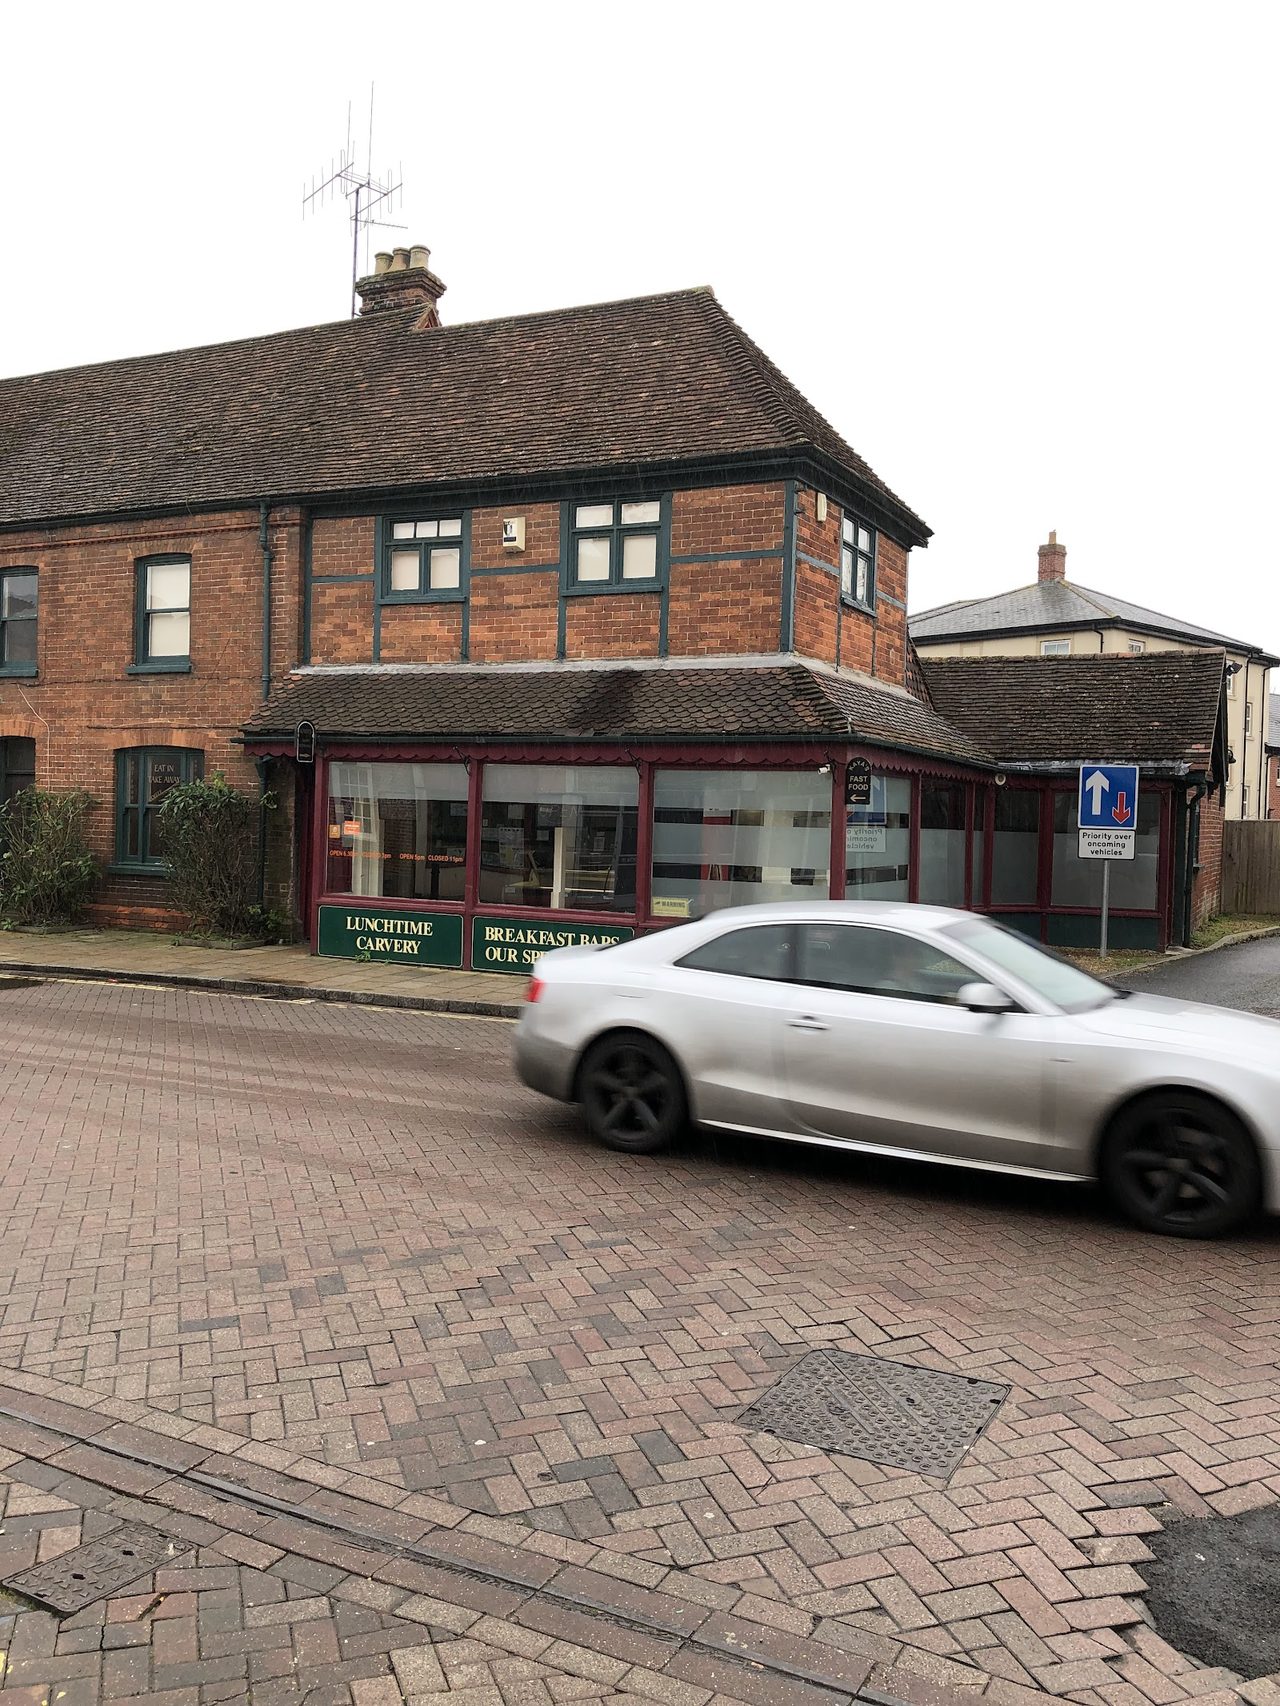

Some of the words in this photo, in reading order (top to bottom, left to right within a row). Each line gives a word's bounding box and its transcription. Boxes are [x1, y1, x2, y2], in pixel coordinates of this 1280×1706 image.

[154, 764, 166, 772] EAT
[167, 764, 174, 772] IN
[848, 760, 870, 772] KAYA'S
[147, 776, 162, 784] TAKE
[163, 776, 180, 784] AWAY
[849, 775, 868, 783] FAST
[848, 783, 869, 791] FOOD
[1082, 832, 1112, 840] Priority
[1087, 841, 1126, 849] oncoming
[346, 916, 434, 936] LUNCHTIME
[484, 926, 576, 947] BREAKFAST
[356, 936, 421, 954] CARVERY
[485, 946, 518, 963] OUR
